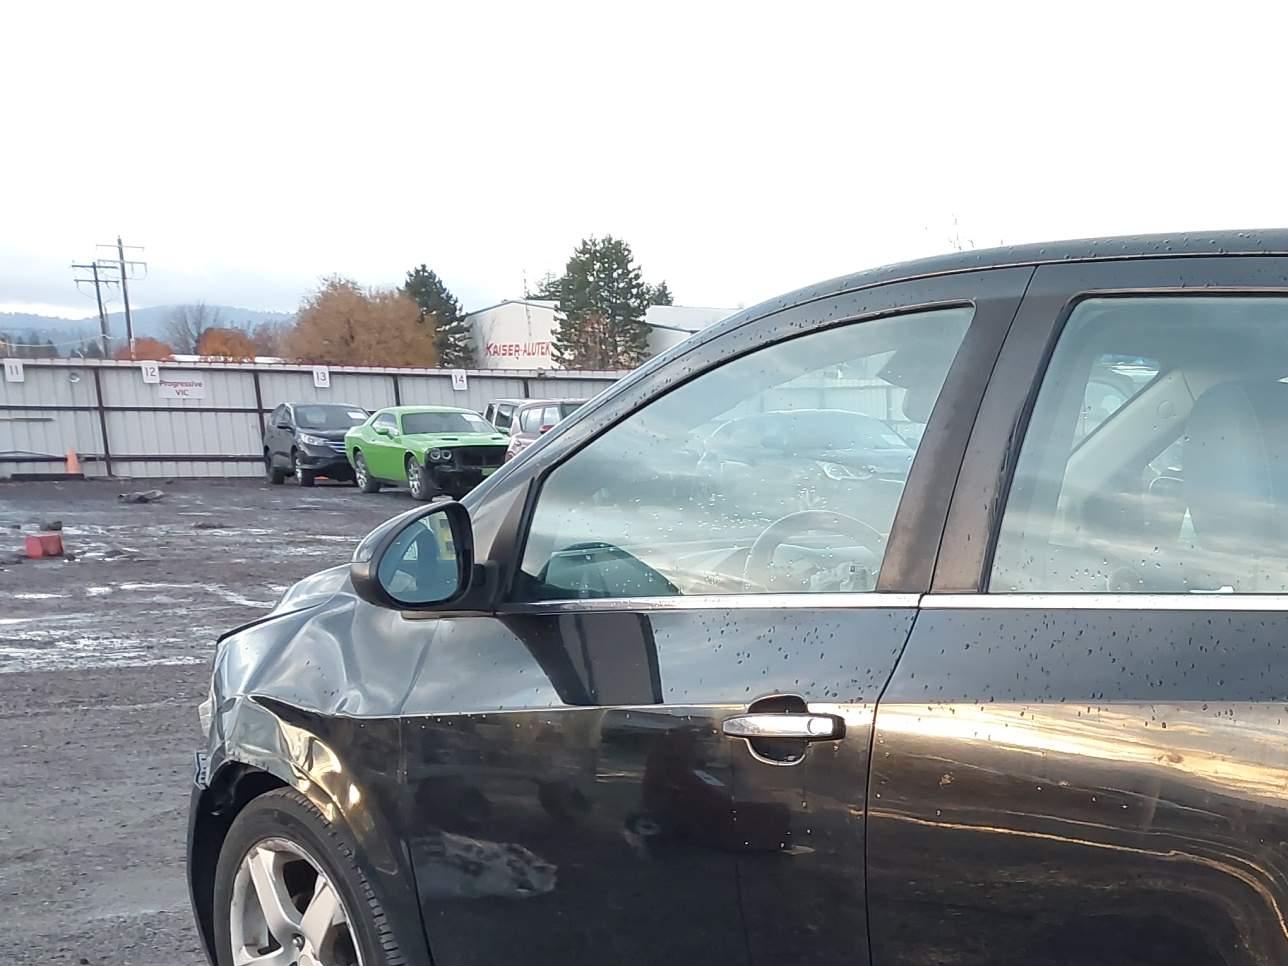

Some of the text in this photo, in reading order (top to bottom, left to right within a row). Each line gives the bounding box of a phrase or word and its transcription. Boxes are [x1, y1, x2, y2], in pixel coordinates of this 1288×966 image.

[9, 365, 19, 376] 11
[144, 366, 156, 377] 12
[316, 371, 327, 382] 13
[454, 374, 465, 384] 14
